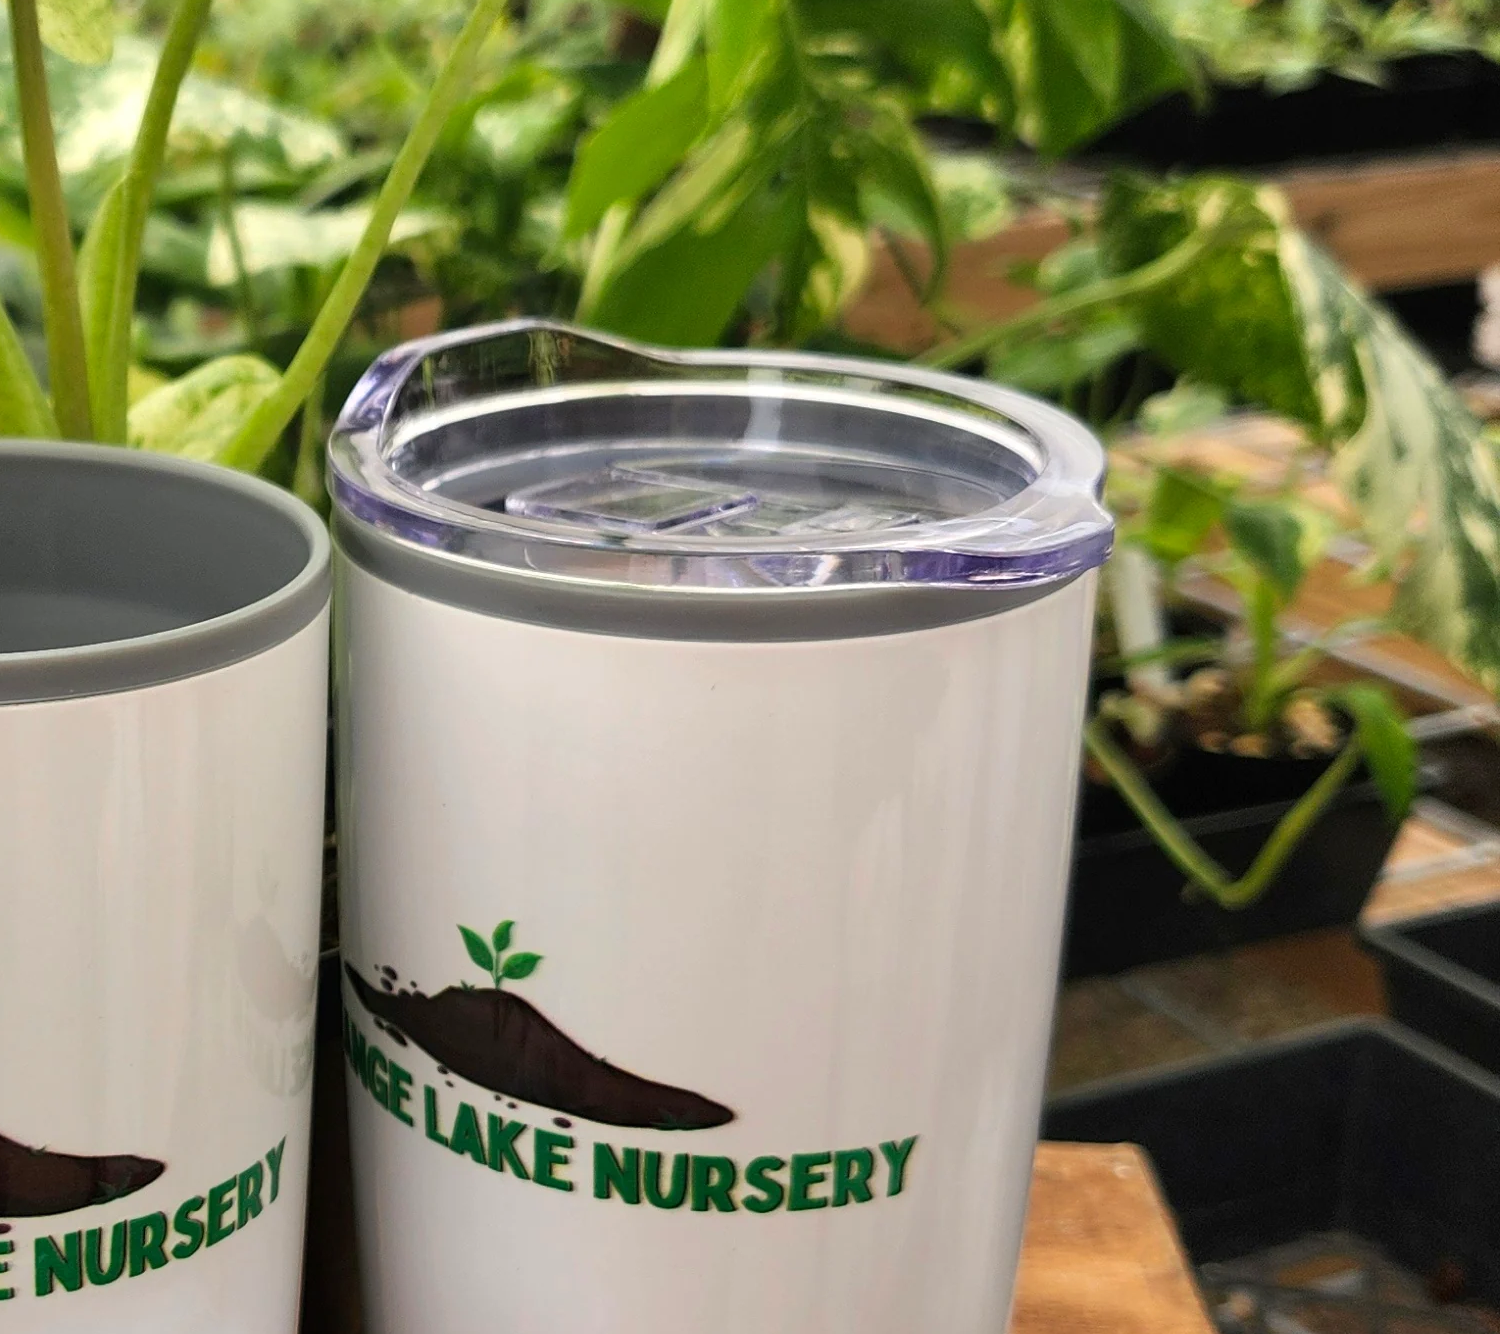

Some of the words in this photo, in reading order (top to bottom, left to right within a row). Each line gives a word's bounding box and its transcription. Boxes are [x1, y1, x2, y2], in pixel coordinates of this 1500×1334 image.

[34, 1133, 288, 1298] NURSERY
[424, 1083, 574, 1193] LAKE
[593, 1133, 920, 1214] NURSERY
